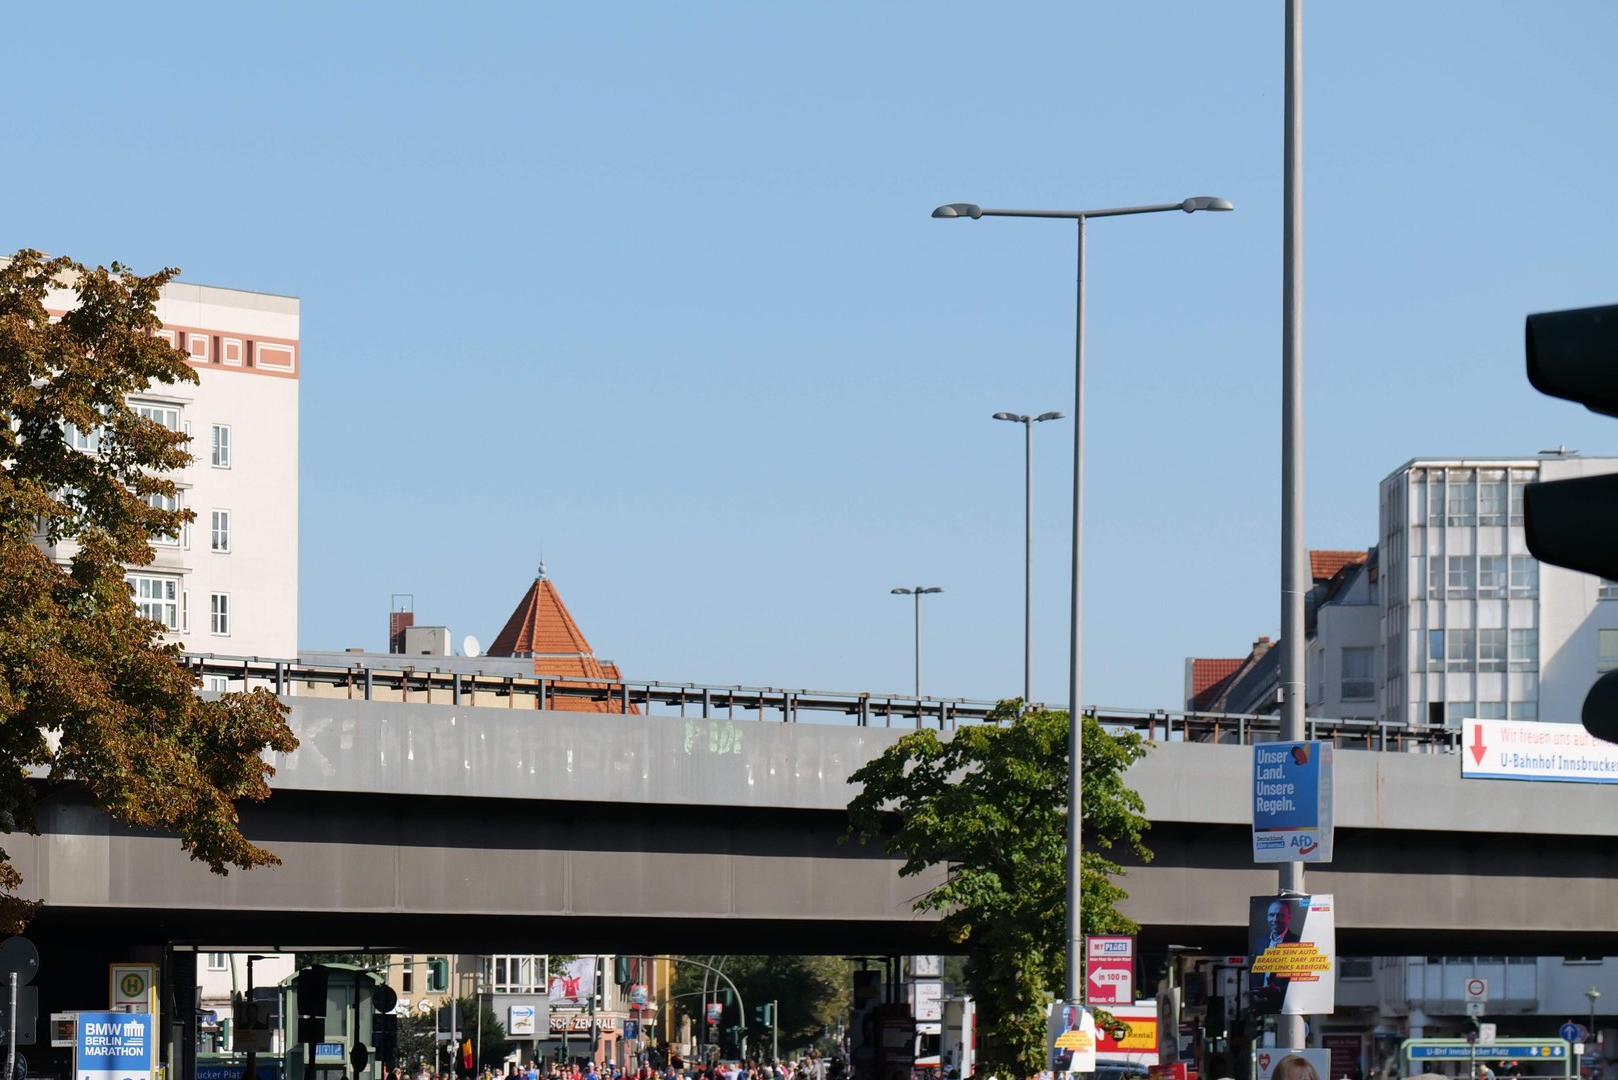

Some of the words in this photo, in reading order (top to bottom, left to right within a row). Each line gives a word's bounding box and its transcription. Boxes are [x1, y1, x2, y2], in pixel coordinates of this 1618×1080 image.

[1500, 727, 1517, 743] Wir
[1519, 728, 1551, 745] freuen
[1553, 733, 1571, 746] uns
[1574, 733, 1589, 747] auf
[1257, 748, 1289, 764] Unser
[1500, 752, 1556, 770] U-Bahnhof
[1256, 764, 1286, 780] Land.
[1256, 780, 1295, 796] Unsere
[1256, 796, 1296, 816] Regeln.
[1290, 835, 1313, 848] AfD
[1104, 943, 1128, 951] PLACE
[1107, 973, 1120, 981] 100
[127, 979, 138, 992] H
[85, 1023, 122, 1036] BMW
[549, 1019, 567, 1028] SCH
[575, 1019, 615, 1029] ZENRALE
[85, 1036, 122, 1046] BERLIN
[1126, 1031, 1154, 1039] Rental
[85, 1047, 144, 1056] MARATHON
[1449, 1046, 1489, 1056] Innsbrcker
[1491, 1047, 1509, 1056] Platz
[196, 1070, 222, 1080] ucker
